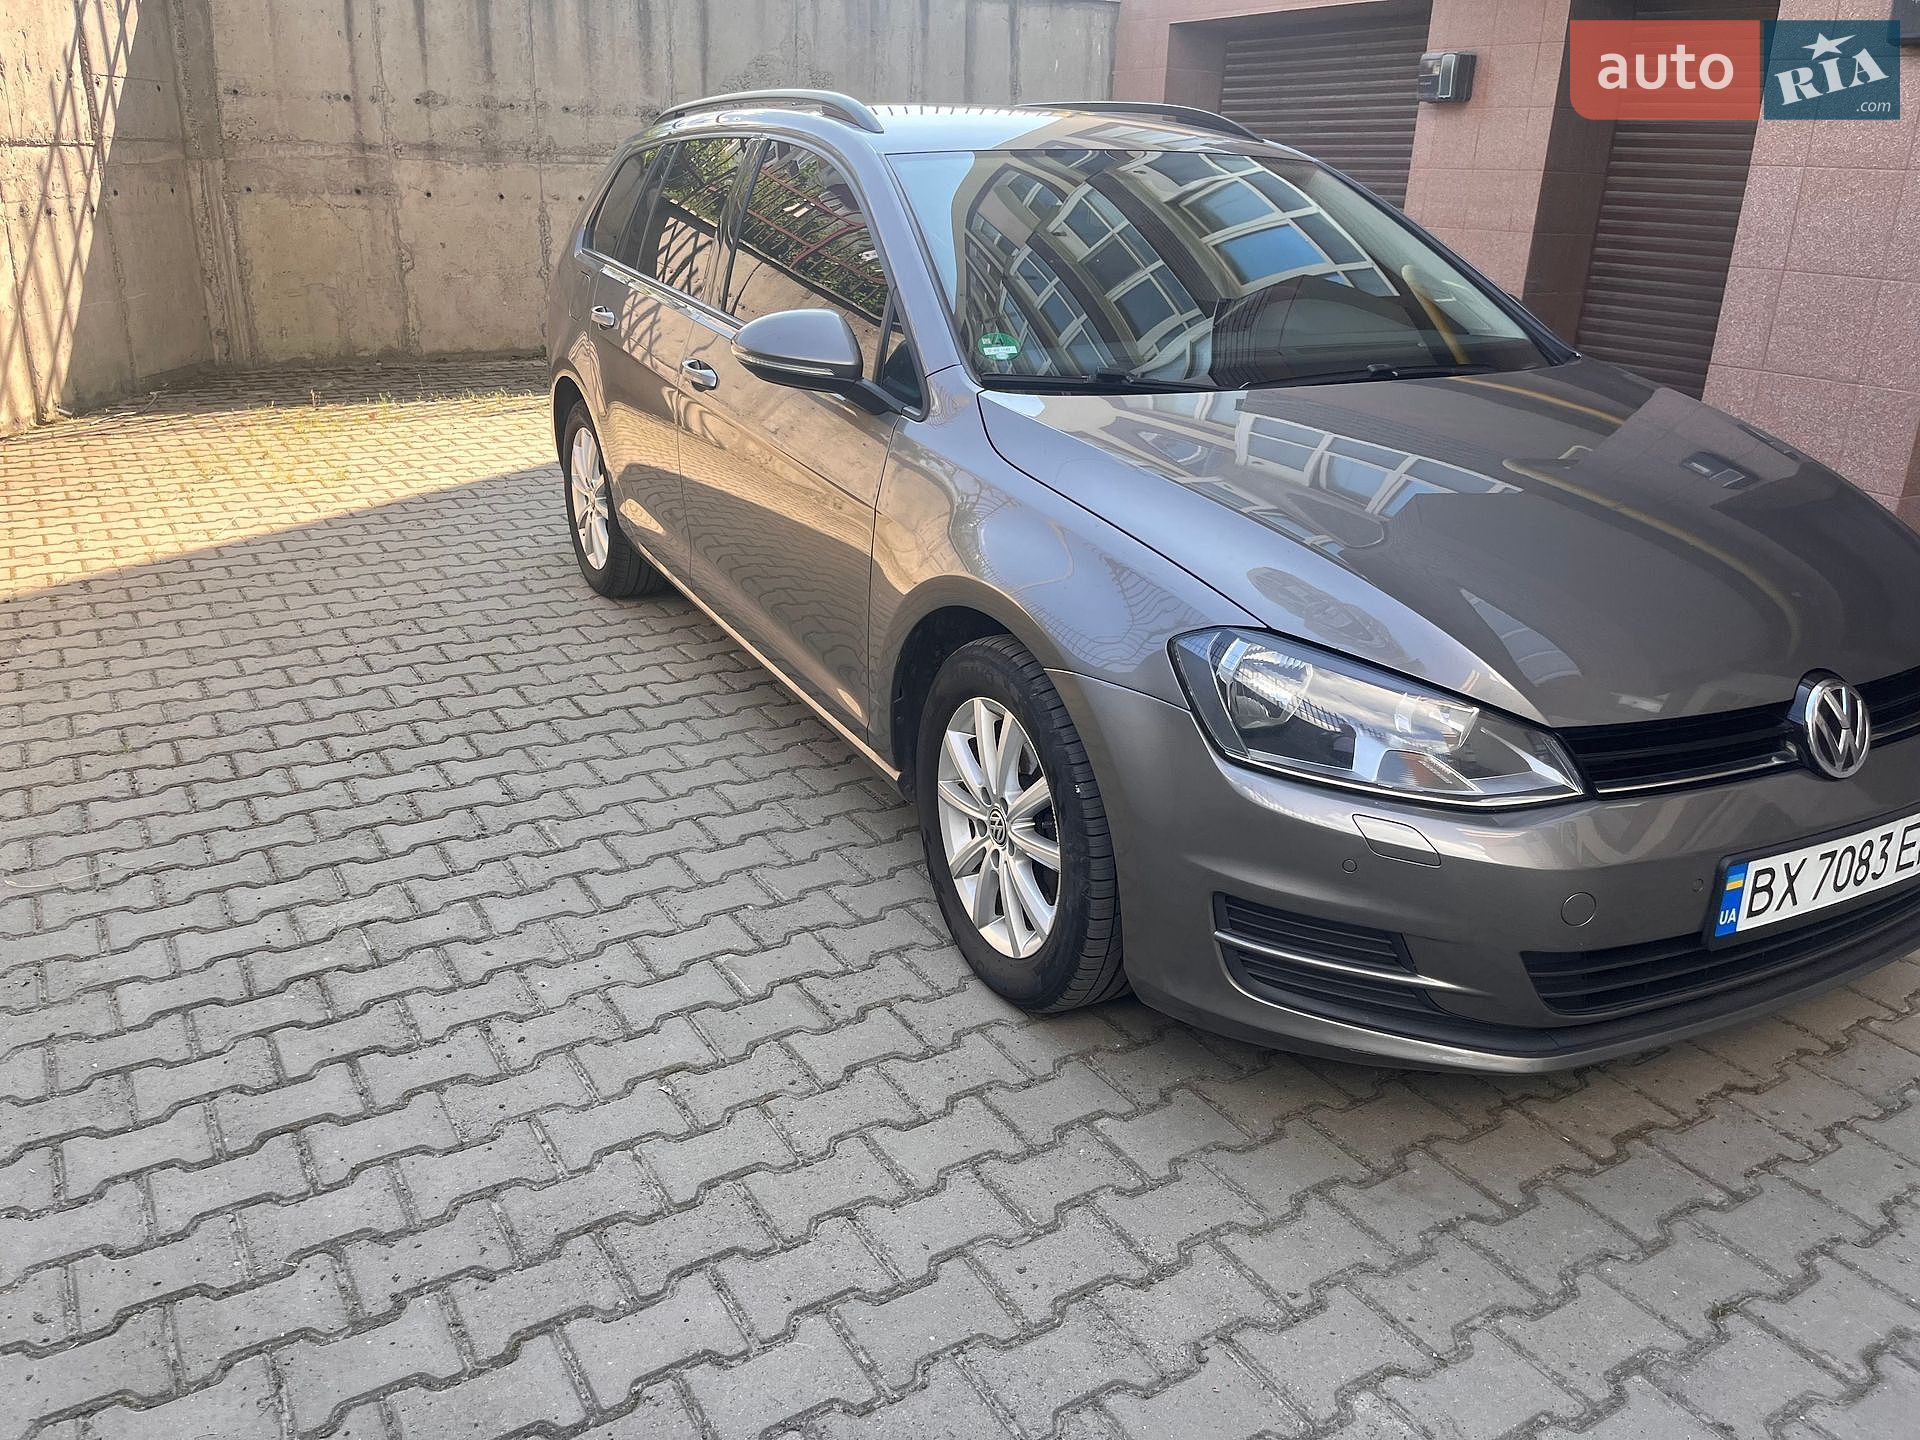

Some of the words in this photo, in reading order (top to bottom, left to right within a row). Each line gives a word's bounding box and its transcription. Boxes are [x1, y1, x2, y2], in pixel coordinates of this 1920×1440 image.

[1746, 857, 1807, 919] BX
[1812, 831, 1894, 901] 7083
[1895, 822, 1920, 873] E
[1719, 908, 1737, 925] UA
